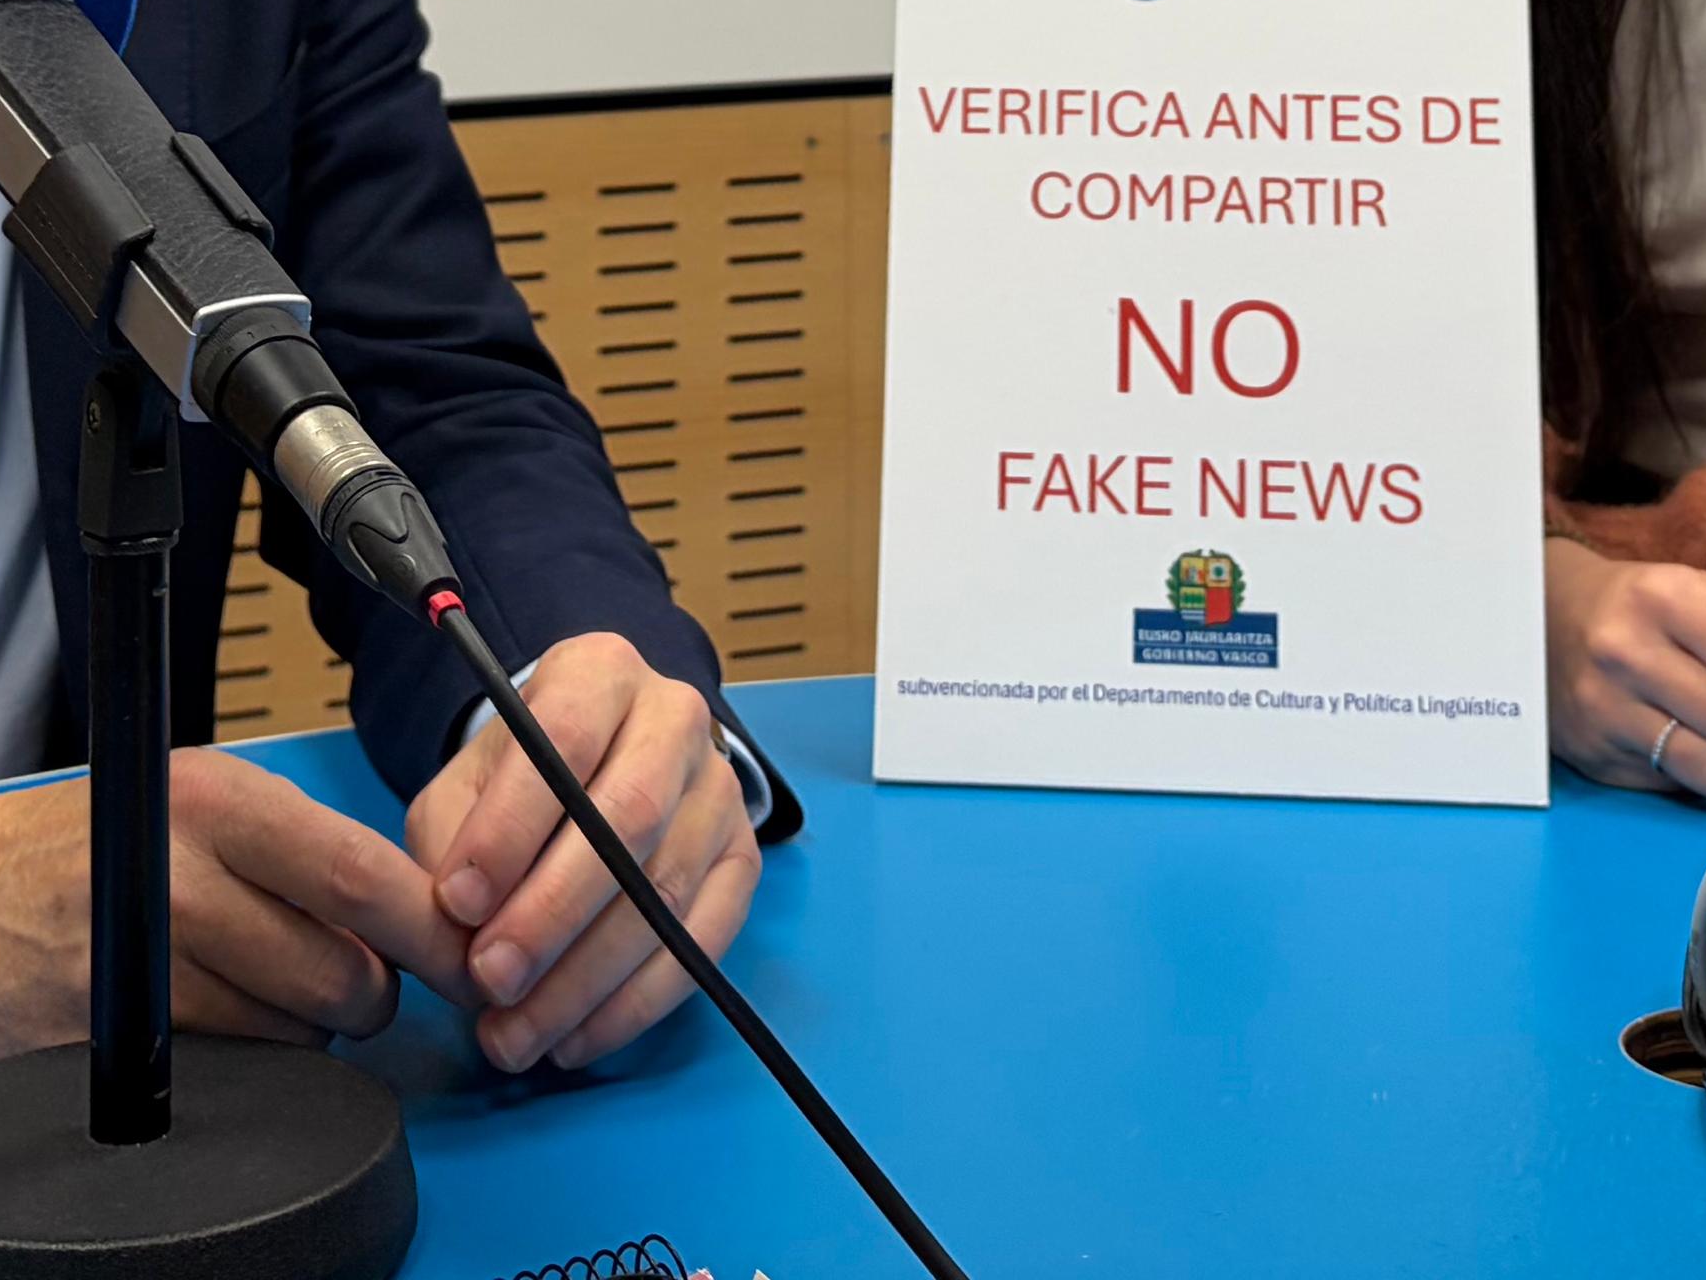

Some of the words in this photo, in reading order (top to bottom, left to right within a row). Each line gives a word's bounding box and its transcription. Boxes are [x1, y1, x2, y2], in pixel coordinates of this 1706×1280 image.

[919, 86, 1191, 138] VERIFICA
[1204, 92, 1402, 143] ANTES
[1422, 96, 1502, 145] DE
[1030, 171, 1388, 227] COMPARTIR
[1116, 296, 1301, 399] NO
[996, 451, 1173, 517] FAKE
[1198, 456, 1424, 525] NEWS
[1138, 629, 1183, 642] EUSKO
[1185, 630, 1274, 645] JAURLARITZA
[1142, 648, 1219, 662] GOBIERNO
[1222, 652, 1270, 664] VASCO
[897, 677, 1034, 700] subvencionada
[1037, 682, 1068, 704] por
[1071, 682, 1090, 701] el
[1093, 683, 1224, 706] Departamento
[1227, 691, 1252, 708] de
[1254, 689, 1324, 711] Cultura
[1327, 695, 1340, 714] y
[1343, 692, 1412, 714] Política
[1418, 694, 1521, 720] Lingüística
